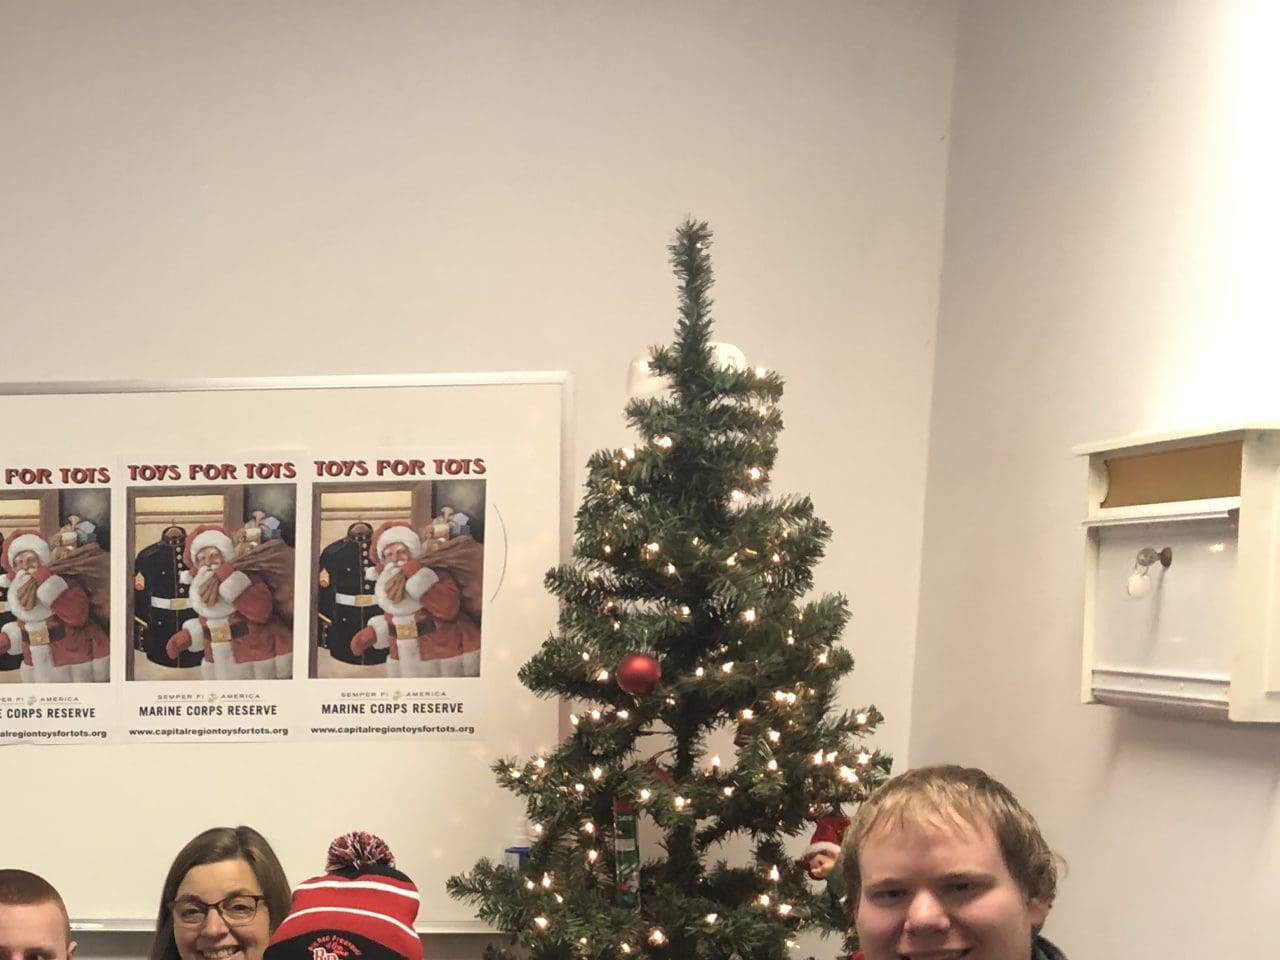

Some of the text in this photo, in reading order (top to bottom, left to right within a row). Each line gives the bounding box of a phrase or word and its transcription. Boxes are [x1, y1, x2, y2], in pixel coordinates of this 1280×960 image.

[127, 462, 297, 481] TOYS FOR TOTS
[314, 458, 487, 477] TOYS FOR TOTS
[5, 468, 53, 485] FOR
[59, 467, 111, 484] TOTS
[6, 708, 43, 718] CORPS
[47, 708, 96, 718] RESERVE
[139, 705, 278, 716] MARINE CORPS RESERVE
[321, 703, 464, 714] MARINE CORPS RESERVE
[129, 727, 289, 737] www.capitalregiontoysfortots.org
[311, 725, 475, 735] www.capitalregiontoysfortots.org
